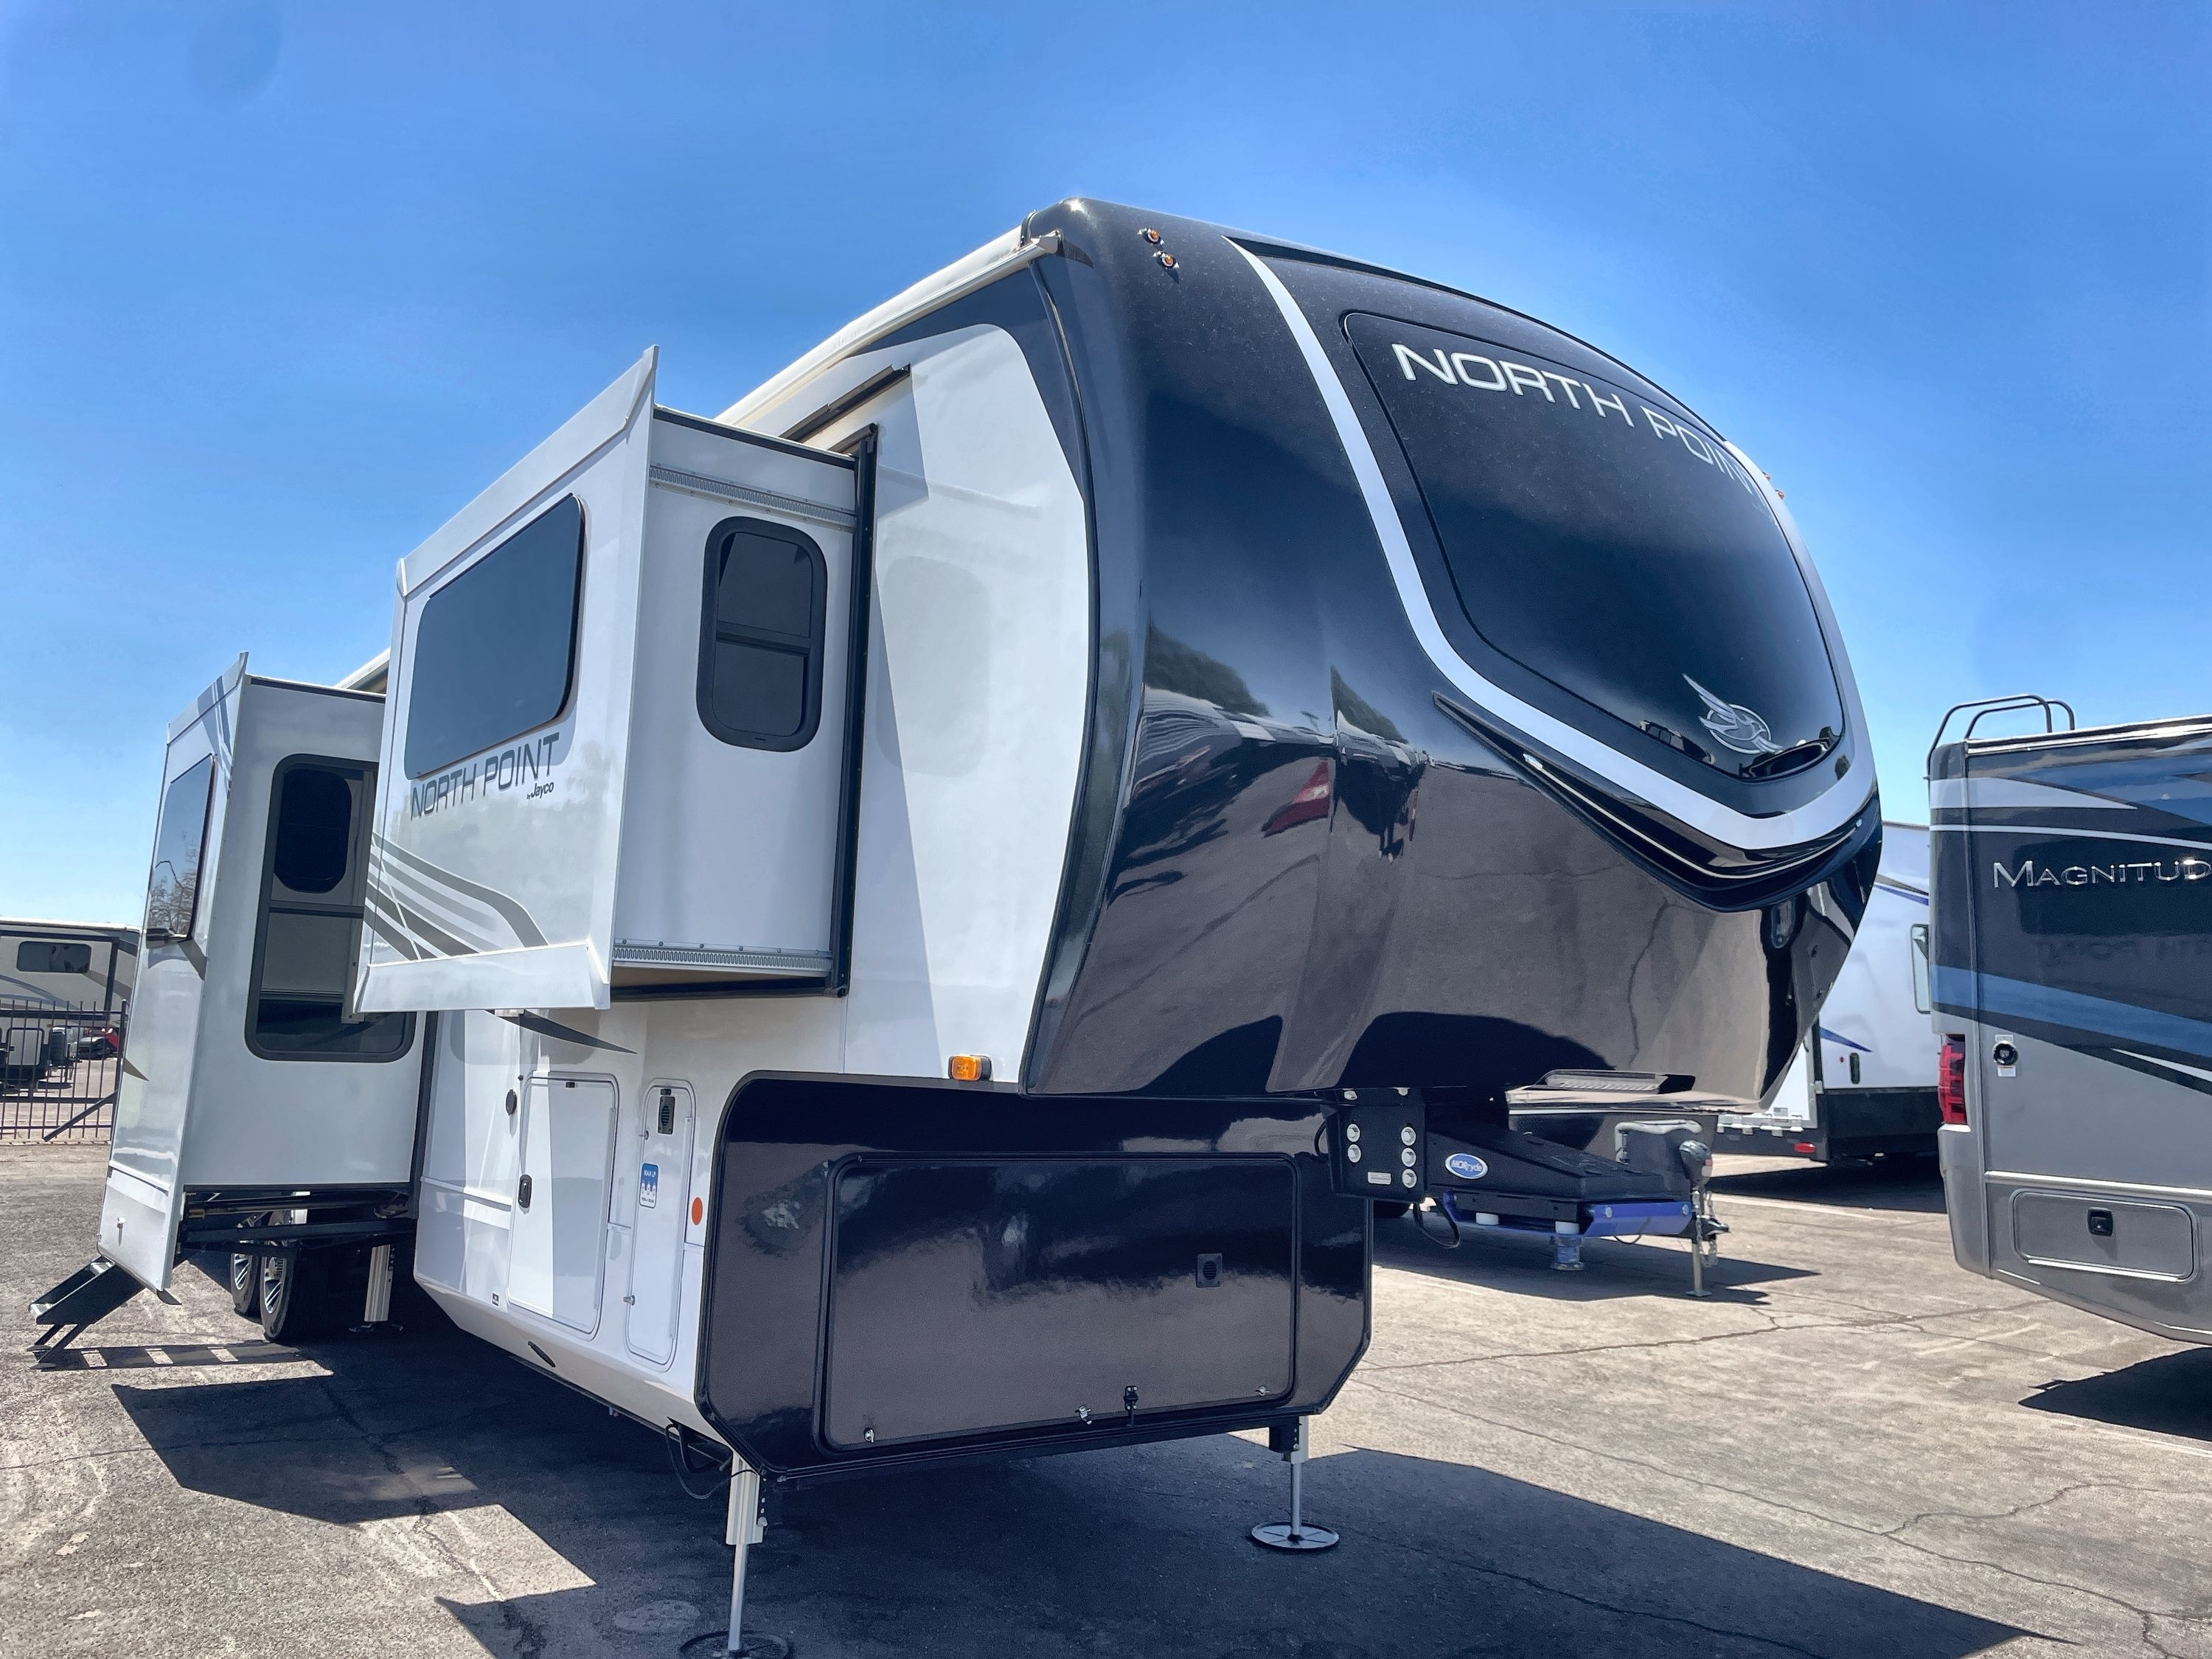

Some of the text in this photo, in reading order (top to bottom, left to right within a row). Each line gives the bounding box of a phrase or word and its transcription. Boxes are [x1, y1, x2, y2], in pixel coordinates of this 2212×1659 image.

[1391, 343, 1635, 428] NORTH
[410, 732, 560, 821] NORTH POINT
[531, 782, 554, 799] Jayco
